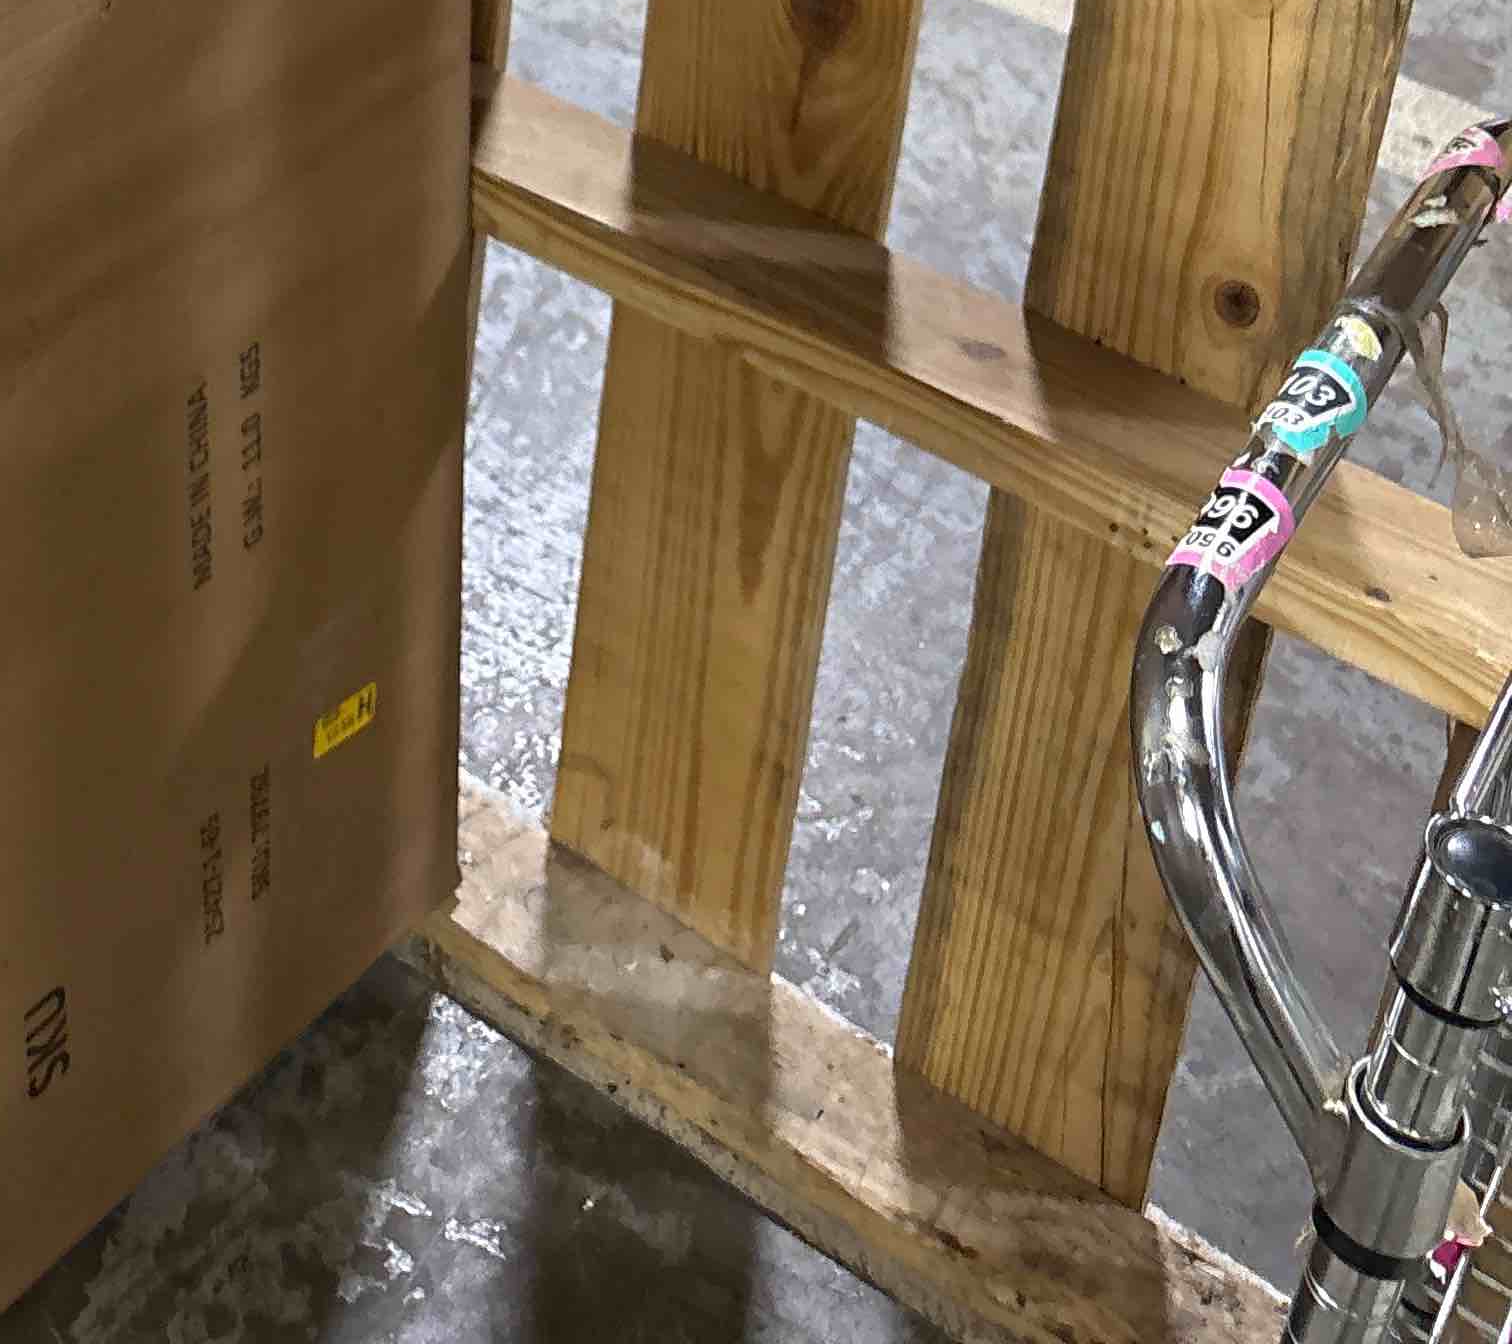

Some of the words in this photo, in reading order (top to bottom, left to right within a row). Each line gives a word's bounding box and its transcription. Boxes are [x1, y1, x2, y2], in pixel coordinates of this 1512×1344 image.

[188, 377, 210, 473] CHINA
[189, 471, 211, 507] IN
[191, 506, 213, 592] MADE
[23, 985, 71, 1100] SKU
